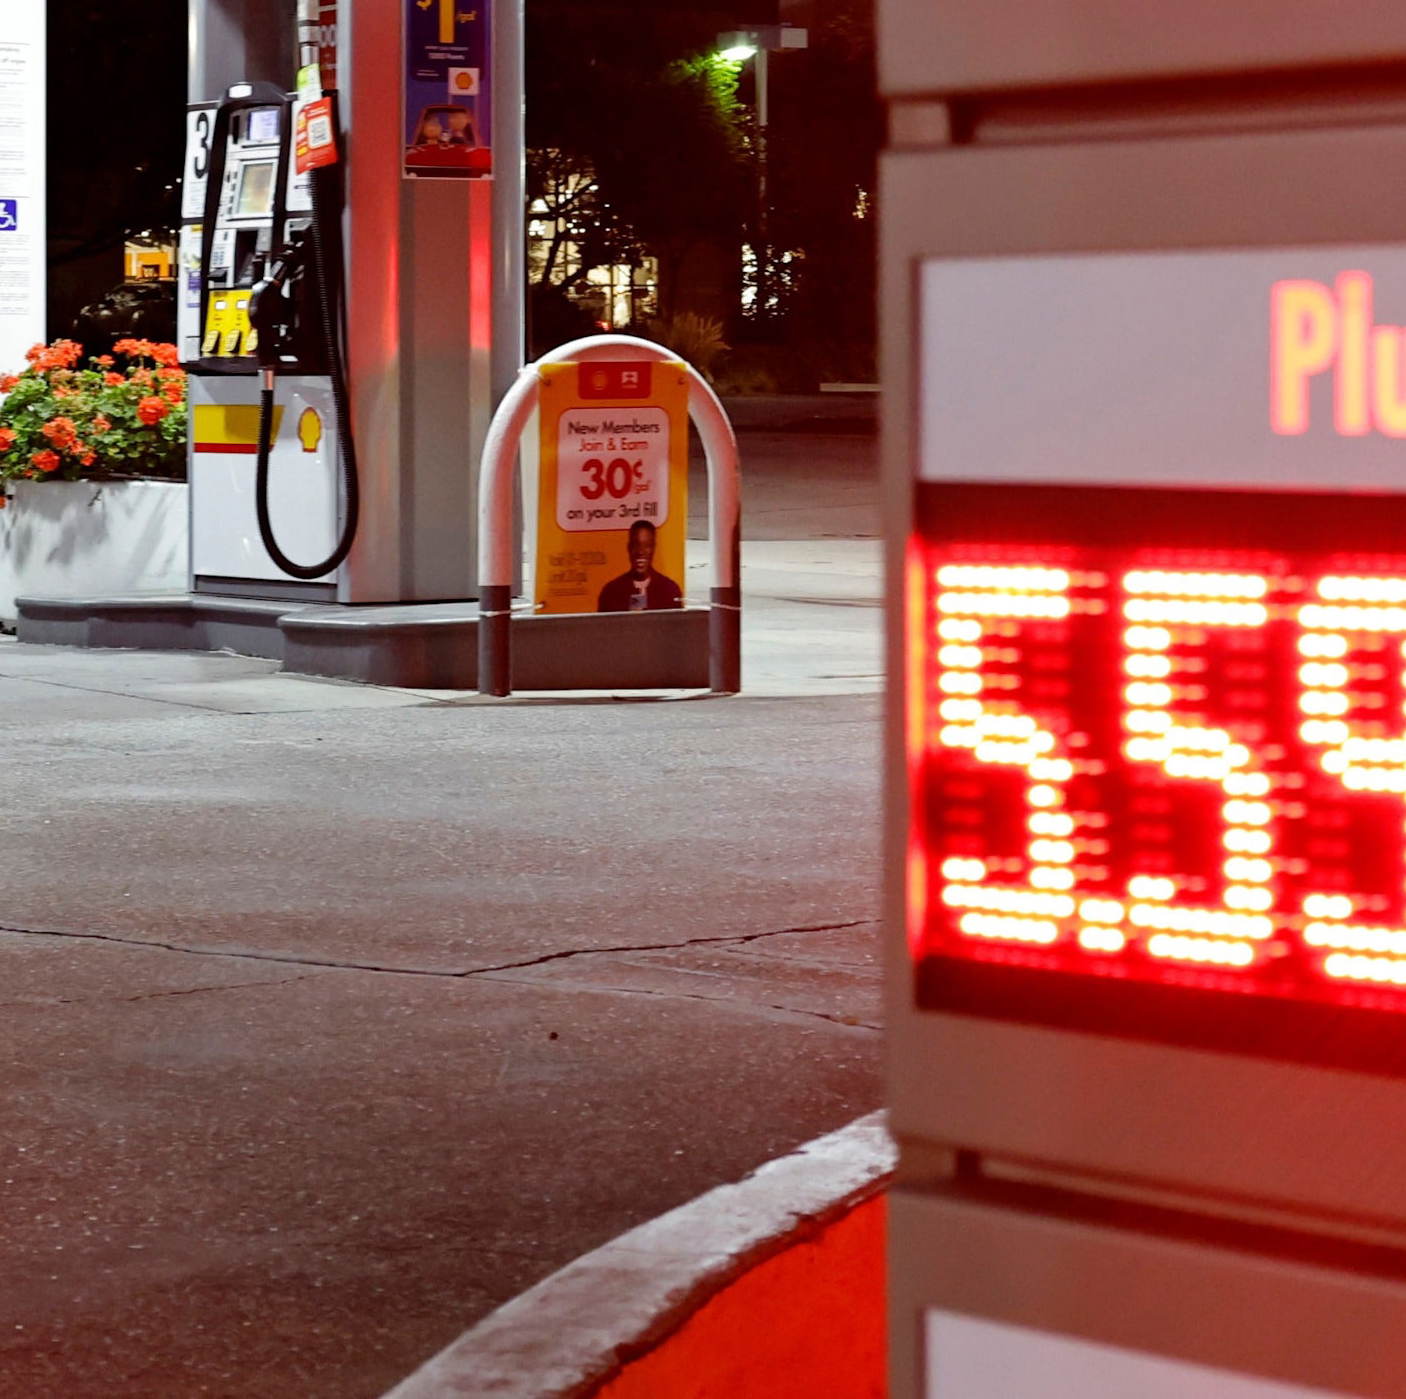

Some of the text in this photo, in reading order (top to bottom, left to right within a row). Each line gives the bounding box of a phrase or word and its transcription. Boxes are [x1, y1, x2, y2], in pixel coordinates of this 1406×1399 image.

[194, 112, 209, 179] 3
[568, 419, 660, 435] New Members
[579, 437, 648, 451] Join & Earn
[566, 502, 657, 522] on your 3rd fill
